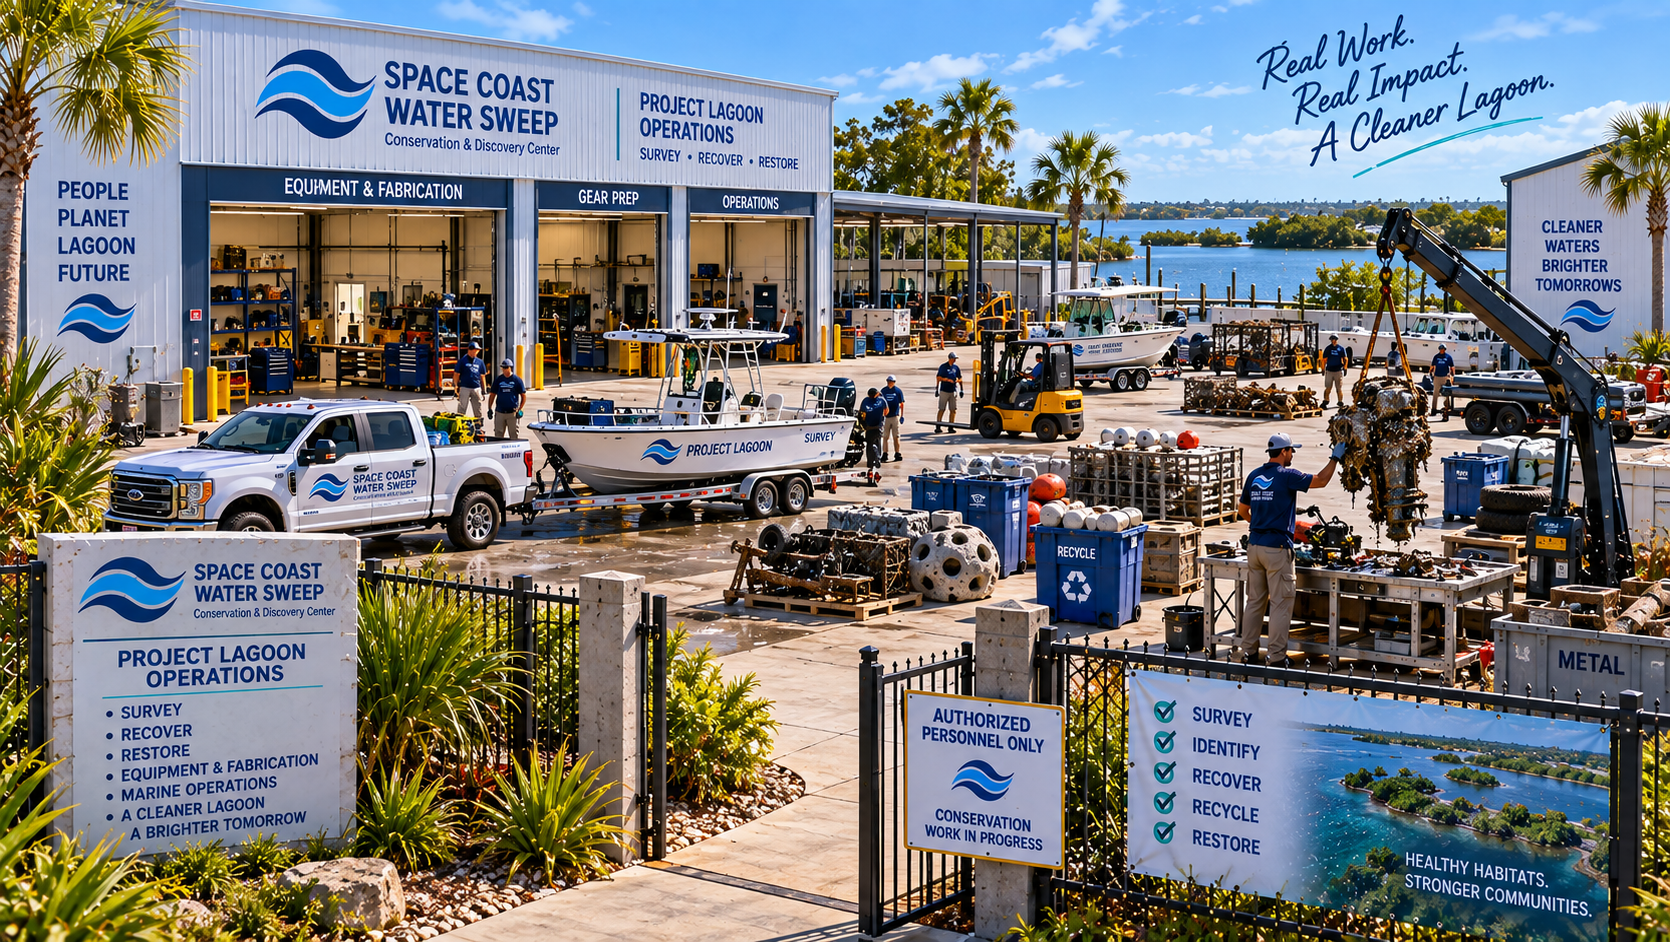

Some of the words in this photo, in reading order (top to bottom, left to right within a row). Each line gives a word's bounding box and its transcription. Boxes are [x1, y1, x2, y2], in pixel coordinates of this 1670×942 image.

[384, 61, 469, 96] SPACE
[477, 71, 554, 103] COAST
[385, 97, 473, 130] WATER
[480, 105, 558, 135] SWEEP
[640, 91, 704, 117] PROJECT
[709, 101, 763, 124] LAGOON
[640, 118, 734, 144] OPERATIONS
[385, 132, 460, 150] Conservation
[463, 138, 472, 150] &
[475, 139, 525, 156] Discovery
[527, 142, 560, 155] Center
[640, 147, 681, 162] SURVEY
[698, 152, 743, 166] RECOVER
[759, 156, 798, 170] RESTORE
[58, 181, 129, 200] PEOPLE
[363, 181, 374, 197] &
[378, 181, 463, 200] FABRICATION
[578, 189, 608, 205] GEAR
[612, 190, 639, 206] PREP
[723, 195, 779, 210] OPERATIONS
[58, 209, 130, 227] PLANET
[1541, 220, 1603, 234] CLEANER
[58, 237, 135, 255] LAGOON
[1545, 239, 1600, 253] WATERS
[58, 264, 130, 282] FUTURE
[1542, 259, 1608, 272] BRIGHTER
[1535, 278, 1622, 293] TOMORROWS
[804, 431, 836, 443] SURVEY
[686, 441, 732, 457] PROJECT
[734, 440, 772, 454] LAGOON
[353, 472, 383, 484] SPACE
[385, 469, 417, 480] COAST
[353, 483, 384, 494] WATER
[387, 480, 417, 491] SWEEP
[1057, 545, 1096, 560] RECYCLE
[193, 563, 255, 581] SPACE
[260, 562, 322, 580] COAST
[194, 585, 257, 602] WATER
[263, 583, 324, 600] SWEEP
[193, 608, 252, 619] Conservation
[253, 608, 261, 617] &
[262, 606, 304, 619] Discovery
[307, 606, 336, 617] Center
[118, 646, 213, 668] PROJECT
[220, 643, 306, 663] LAGOON
[1558, 650, 1625, 675] METAL
[146, 665, 284, 688] OPERATIONS
[121, 702, 182, 719] SURVEY
[933, 708, 1031, 733] AUTHORIZED
[1192, 706, 1252, 728] SURVEY
[121, 723, 192, 741] RECOVER
[922, 726, 1004, 749] PERSONNEL
[1007, 736, 1044, 753] ONLY
[121, 744, 190, 762] RESTORE
[1193, 737, 1260, 760] IDENTIFY
[121, 762, 209, 782] EQUIPMENT
[213, 761, 223, 774] &
[227, 753, 319, 772] FABRICATION
[121, 783, 181, 802] MARINE
[185, 775, 277, 796] OPERATIONS
[1193, 768, 1261, 792] RECOVER
[121, 809, 132, 822] A
[136, 802, 202, 821] CLEANER
[207, 796, 265, 814] LAGOON
[935, 808, 1031, 832] CONSERVATION
[1192, 798, 1259, 823] RECYCLE
[130, 827, 141, 841] A
[146, 820, 219, 839] BRIGHTER
[223, 811, 307, 831] TOMORROW
[925, 824, 961, 841] WORK
[964, 829, 976, 843] IN
[980, 832, 1043, 851] PROGRESS
[1192, 829, 1260, 855] RESTORE
[1406, 852, 1469, 875] HEALTHY
[1474, 862, 1549, 888] HABITATS.
[1405, 873, 1480, 900] STRONGER
[1485, 886, 1592, 917] COMMUNITIES.
